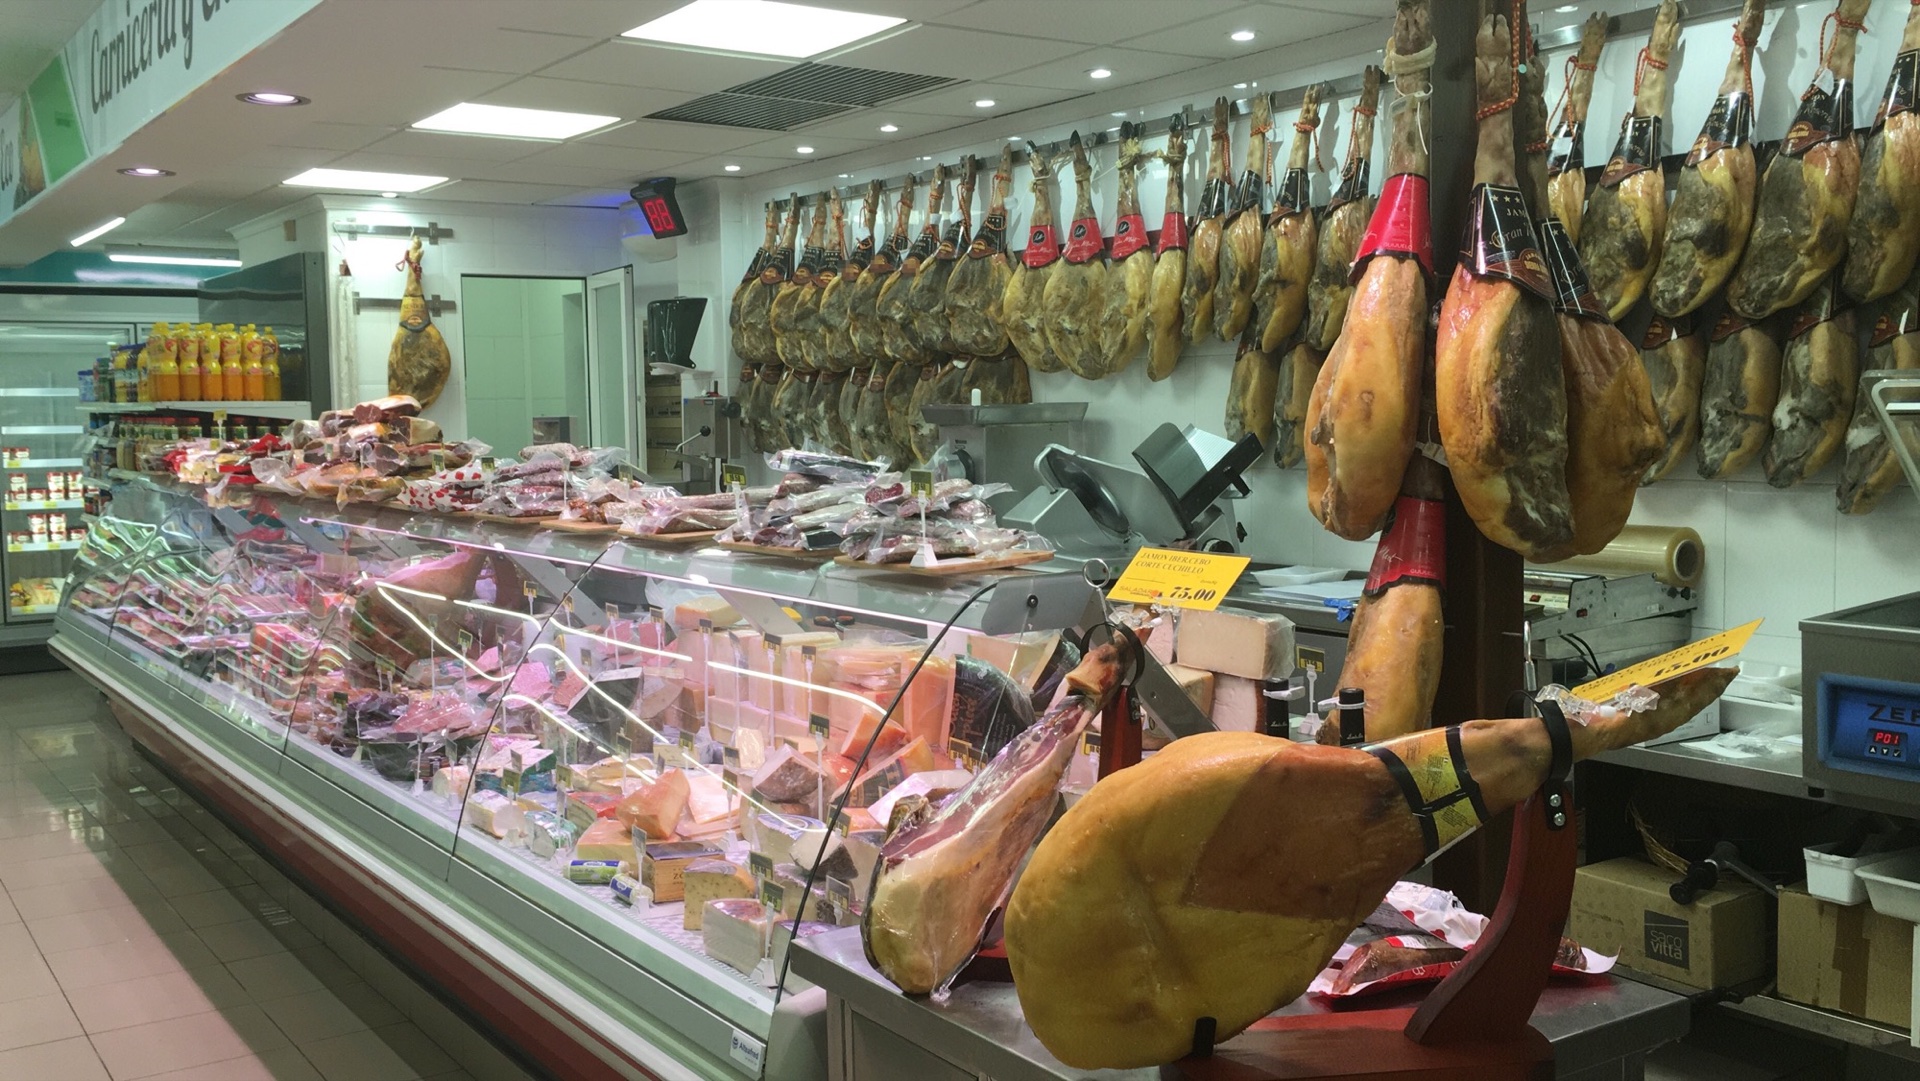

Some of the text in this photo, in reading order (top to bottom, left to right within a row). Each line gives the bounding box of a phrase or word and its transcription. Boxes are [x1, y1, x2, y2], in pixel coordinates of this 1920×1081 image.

[1135, 560, 1204, 574] CORTE CUCHILLO
[1169, 586, 1217, 602] 75.00
[1874, 732, 1899, 745] P01
[1650, 930, 1683, 949] saco
[1650, 941, 1683, 960] vitta
